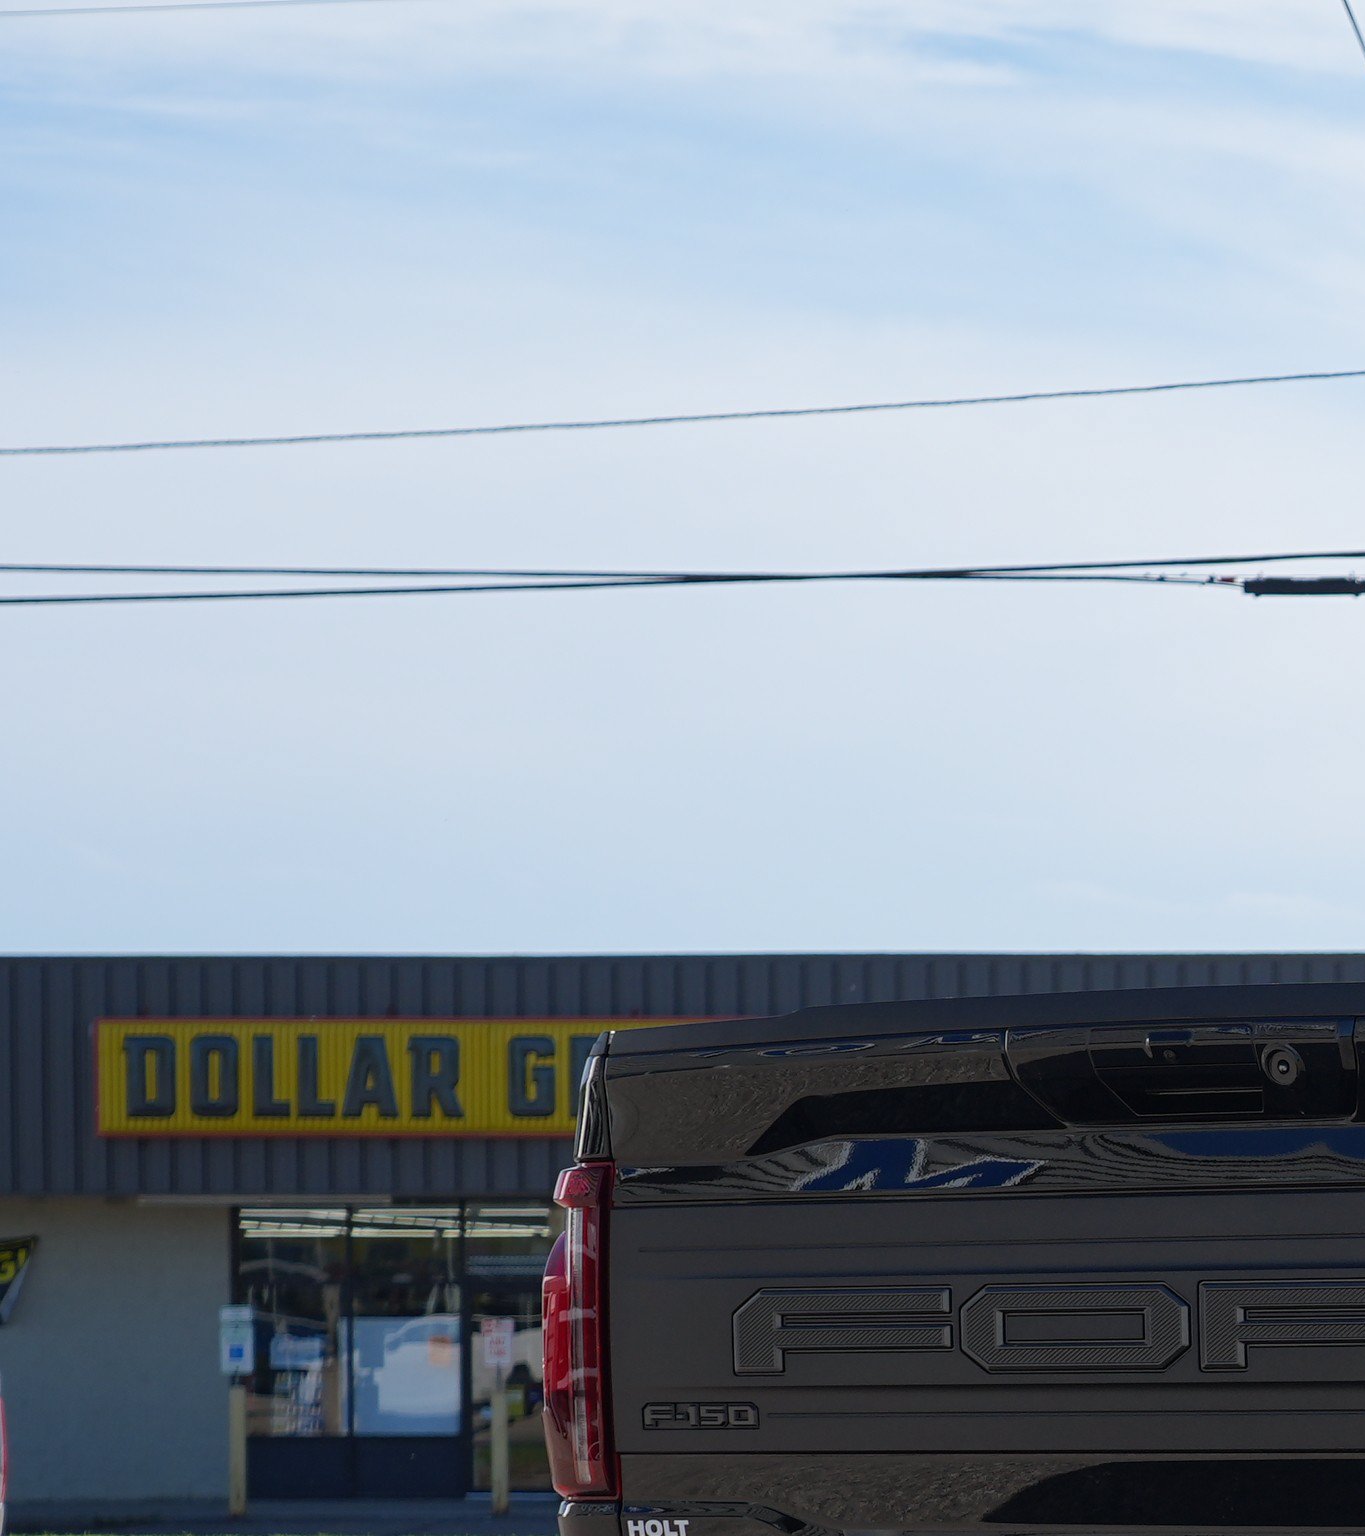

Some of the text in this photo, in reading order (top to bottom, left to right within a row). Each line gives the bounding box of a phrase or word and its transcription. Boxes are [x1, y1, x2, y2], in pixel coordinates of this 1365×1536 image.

[122, 1034, 464, 1119] DOLLAR
[642, 1402, 760, 1430] F-150
[627, 1520, 689, 1536] HOLT
